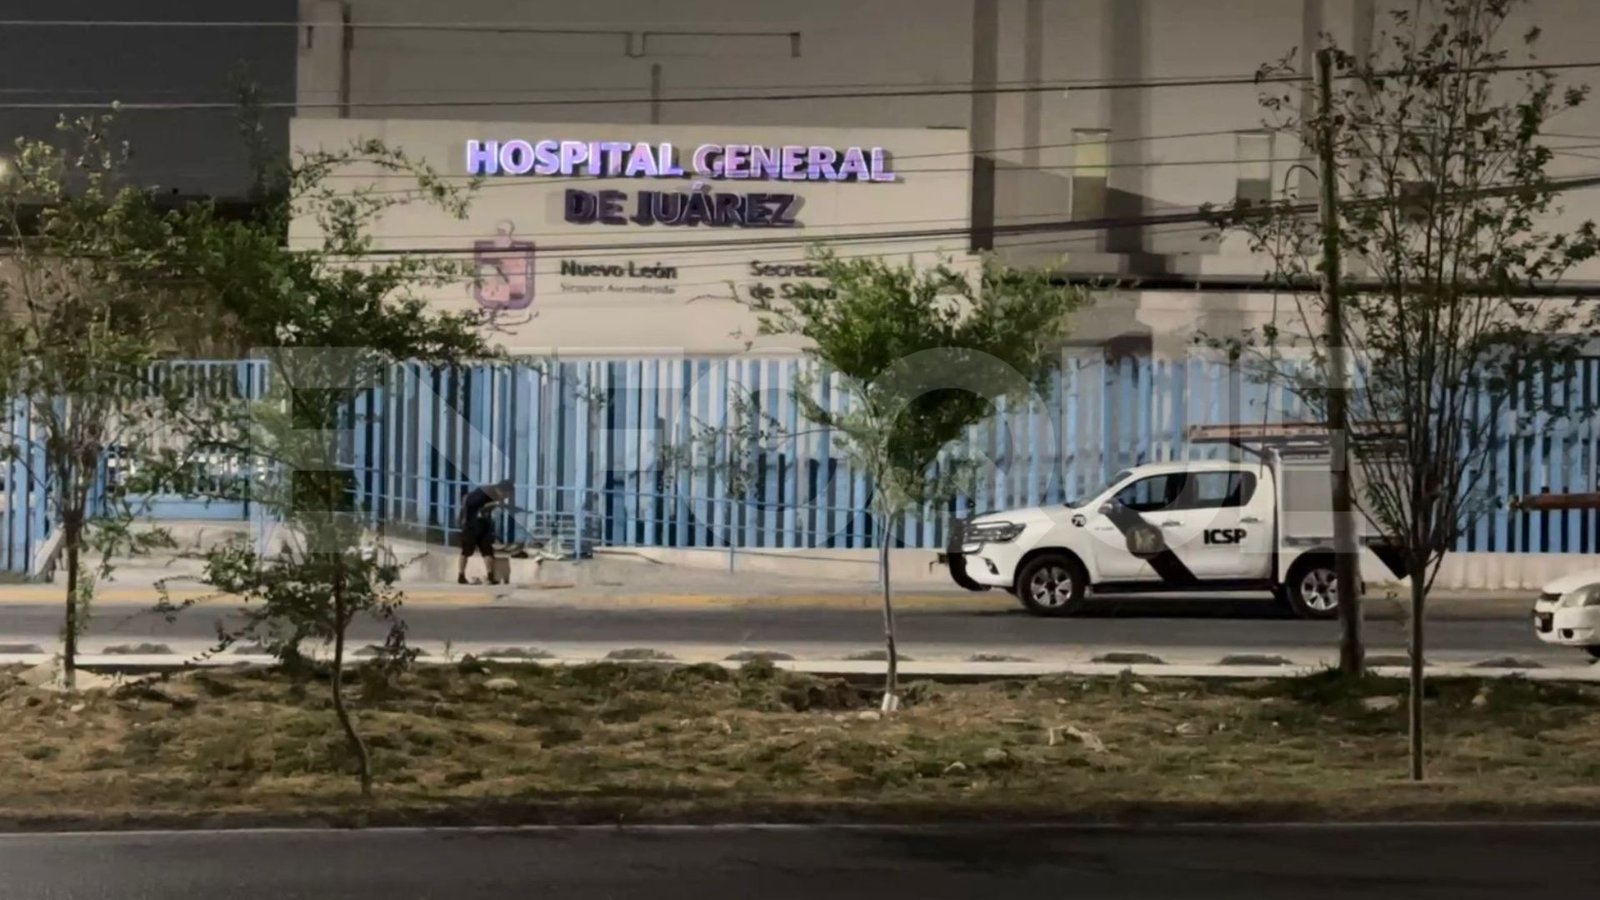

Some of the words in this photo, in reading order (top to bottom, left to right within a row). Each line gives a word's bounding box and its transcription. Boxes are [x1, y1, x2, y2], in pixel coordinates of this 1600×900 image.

[466, 139, 684, 178] HOSPITAL
[692, 144, 896, 182] GENERAL
[564, 188, 628, 225] DE
[630, 182, 800, 227] JUÁREZ
[560, 260, 624, 278] Nuevo
[628, 261, 679, 280] León
[749, 260, 832, 278] Secret
[1203, 528, 1248, 545] ICSP
